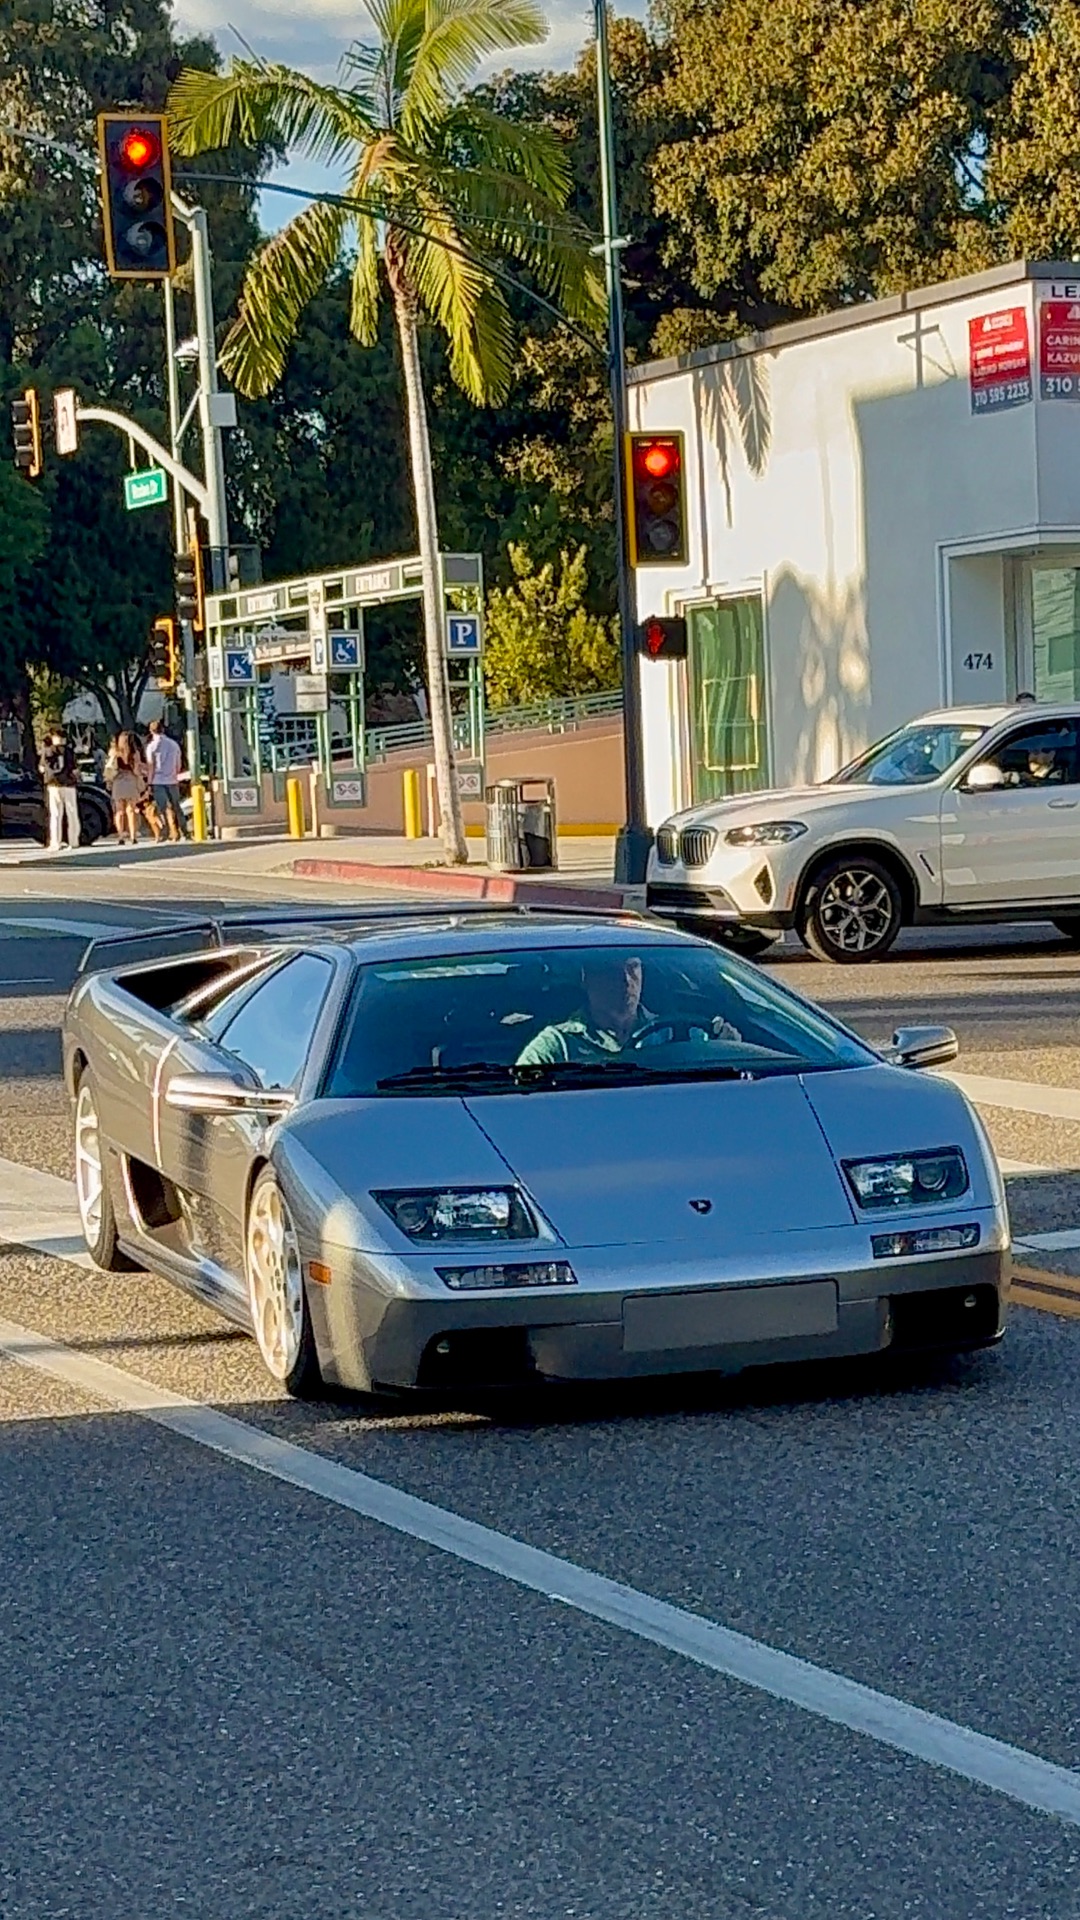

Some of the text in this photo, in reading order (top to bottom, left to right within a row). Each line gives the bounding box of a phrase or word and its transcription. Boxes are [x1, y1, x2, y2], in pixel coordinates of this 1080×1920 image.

[1051, 284, 1080, 298] LE
[1047, 353, 1080, 363] KAZU
[1046, 377, 1072, 392] 310
[975, 390, 988, 406] 310
[1007, 381, 1029, 399] 2233
[456, 623, 473, 645] P
[963, 653, 993, 670] 474
